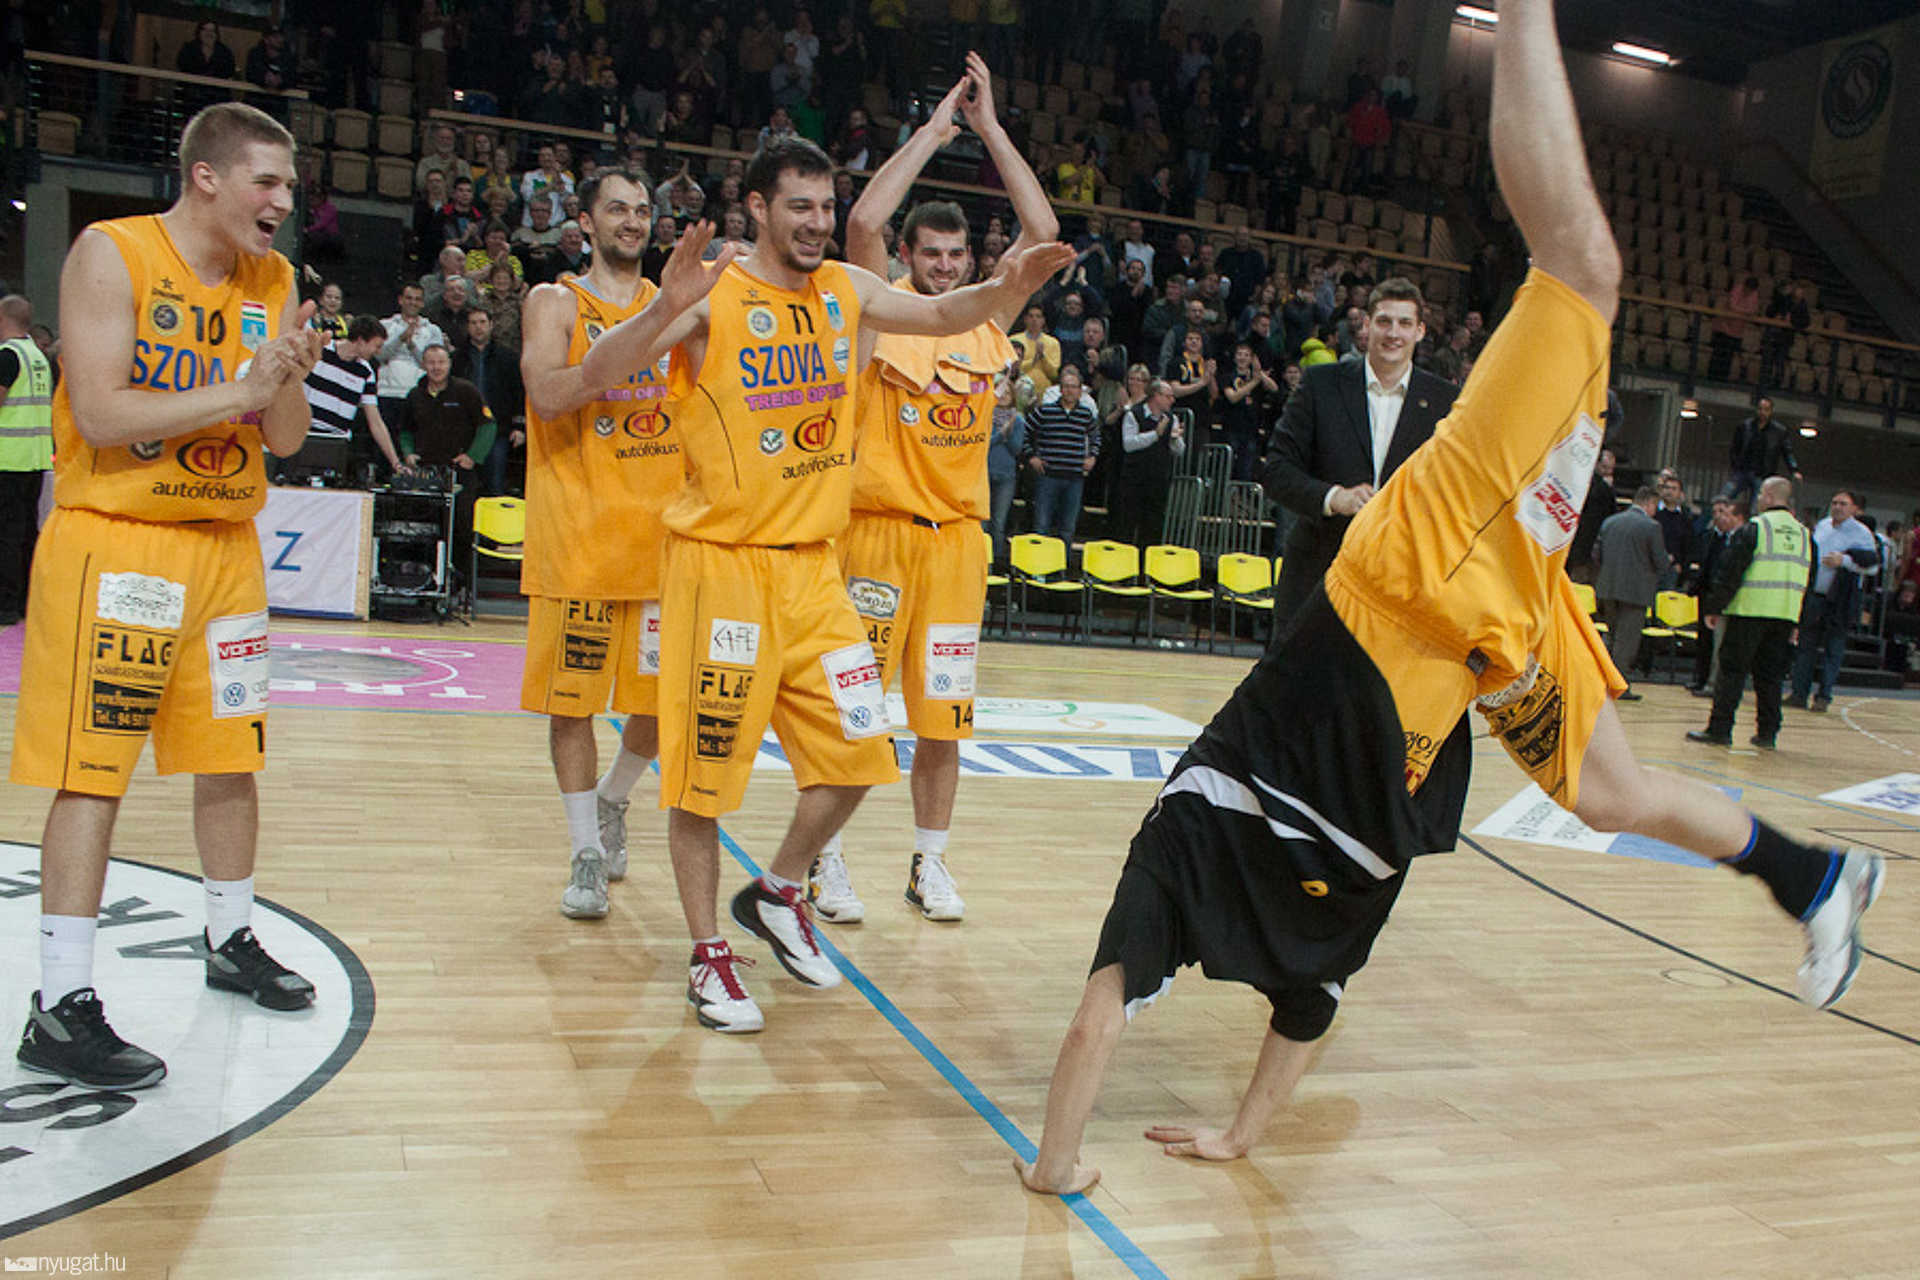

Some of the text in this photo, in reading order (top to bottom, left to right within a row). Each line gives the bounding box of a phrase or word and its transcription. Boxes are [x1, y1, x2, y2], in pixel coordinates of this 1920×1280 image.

[189, 305, 226, 346] 10
[786, 304, 815, 335] 11
[738, 341, 827, 389] SZOVA
[743, 389, 804, 412] TREND
[97, 631, 172, 667] FLAG
[951, 703, 973, 729] 14
